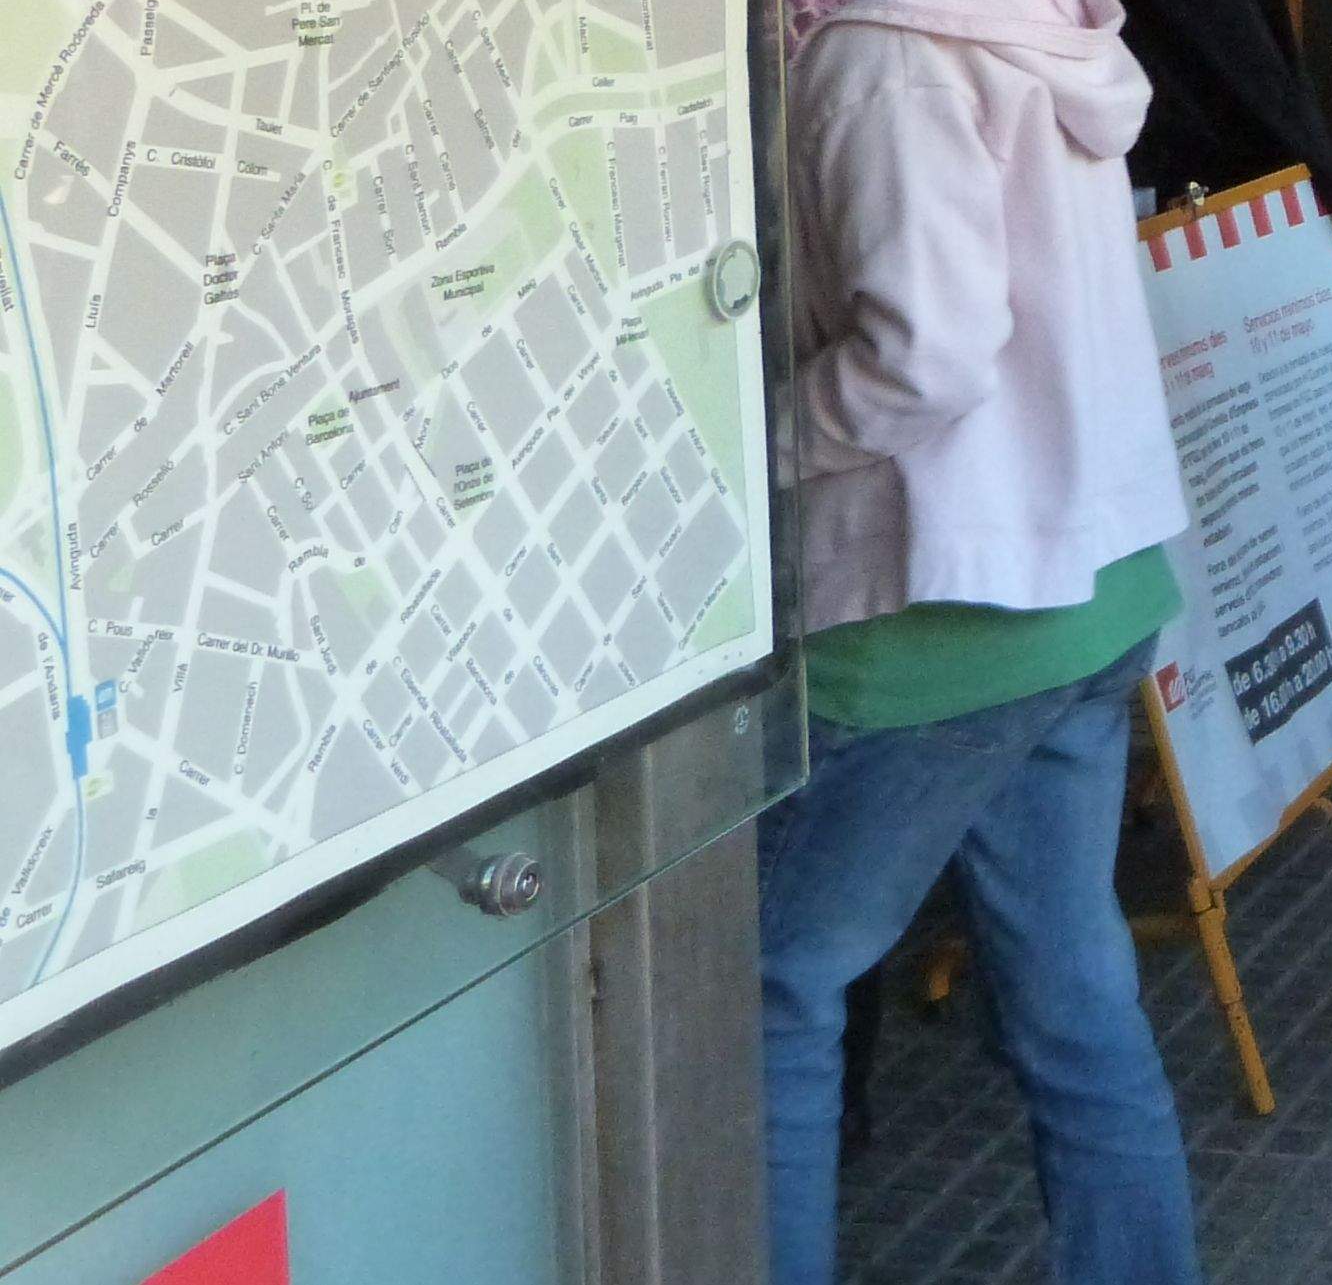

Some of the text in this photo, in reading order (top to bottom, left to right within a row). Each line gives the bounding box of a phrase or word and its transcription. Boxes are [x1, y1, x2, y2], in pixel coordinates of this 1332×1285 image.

[317, 2, 331, 14] de
[14, 132, 36, 181] Carrer
[31, 111, 43, 130] de
[59, 0, 105, 64] Rodoreda
[106, 139, 137, 218] Companys
[155, 341, 195, 397] Martorell
[66, 522, 82, 590] Avinguda
[1232, 671, 1251, 695] de
[16, 903, 53, 929] Carrer
